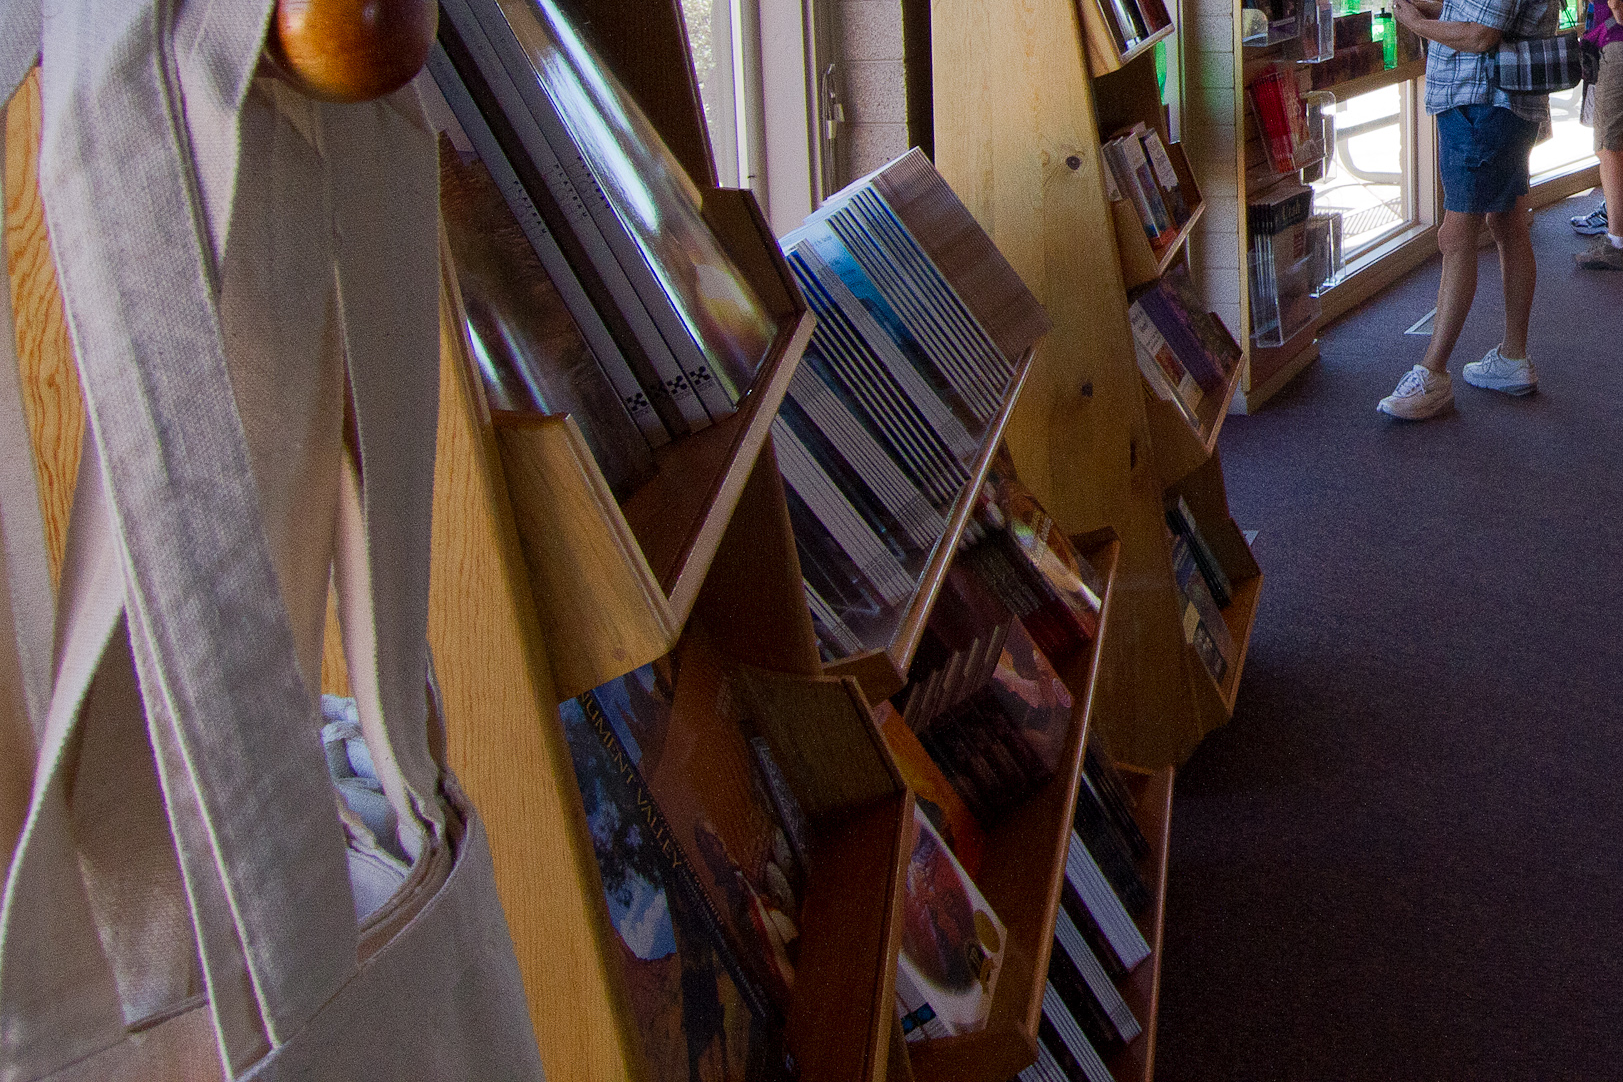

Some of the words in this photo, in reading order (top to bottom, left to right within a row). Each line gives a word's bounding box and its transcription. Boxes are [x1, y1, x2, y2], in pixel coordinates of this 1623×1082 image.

[511, 179, 548, 234] PLATEAU
[552, 163, 589, 218] PLATEAU
[635, 786, 683, 869] VALLEY
